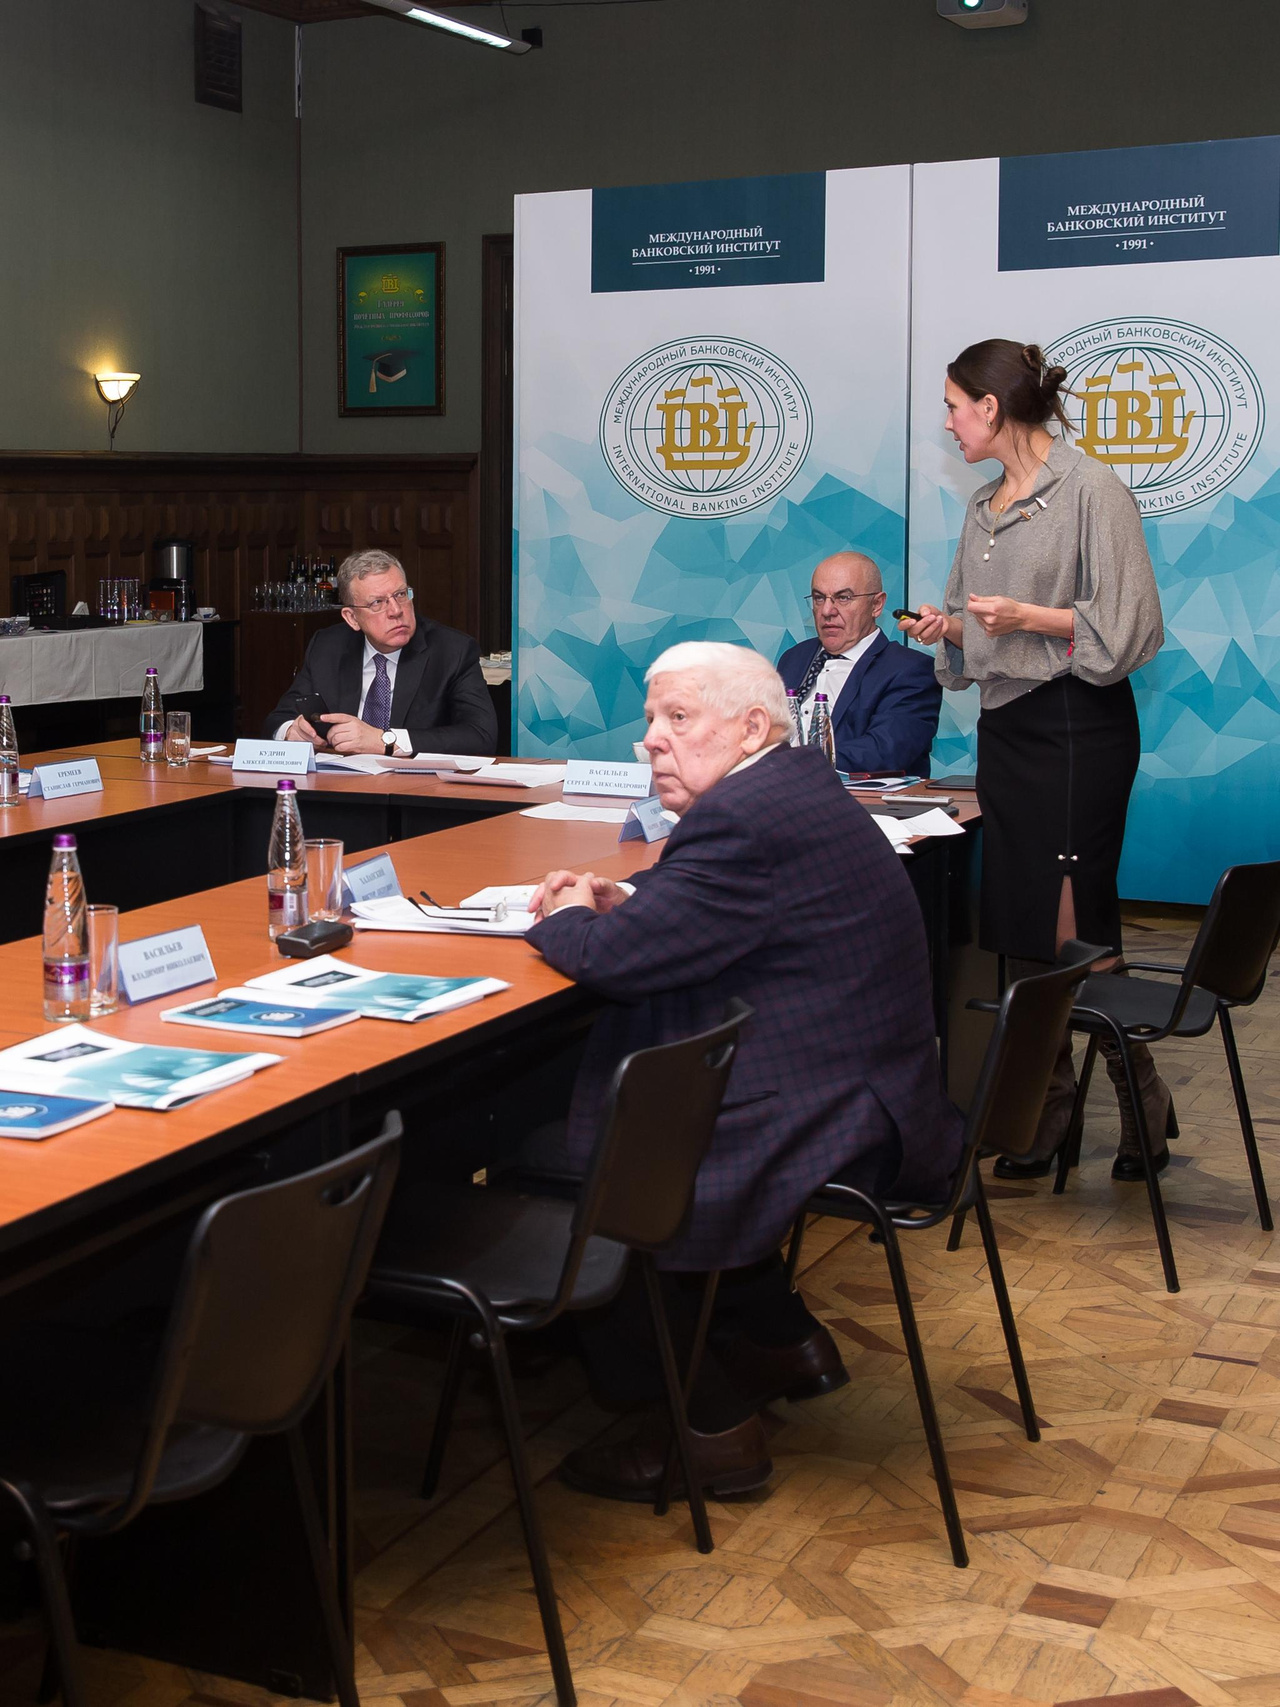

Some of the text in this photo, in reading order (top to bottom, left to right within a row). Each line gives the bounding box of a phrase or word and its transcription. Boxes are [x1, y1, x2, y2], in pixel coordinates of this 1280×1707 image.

[1067, 195, 1205, 216] МЕЖДУНАРОДНЫЙ
[1046, 210, 1226, 233] БАНКОВСКИЙ ИНСТИТУТ
[649, 225, 763, 244] МЕЖДУНАРОДНЫЙ
[632, 240, 781, 258] БАНКОВСКИЙ ИНСТИТУТ
[1121, 239, 1148, 251] 1991
[694, 264, 716, 275] 1991
[1049, 327, 1248, 409] АРОДНЫЙ БАНКОВСКИЙ ИНСТИТУТ
[613, 345, 799, 424] МЕЖДУНАРОДНЫЙ БАНКОВСКИЙ ИНСТИТУТ
[612, 441, 799, 512] INTERNATIONAL BANKING INSTITUTE
[1139, 431, 1248, 509] NKING INSTITUTE
[589, 769, 629, 777] ВАСИЛЬЕВ
[592, 781, 648, 790] АЛЕКСАНДРОВИЧ
